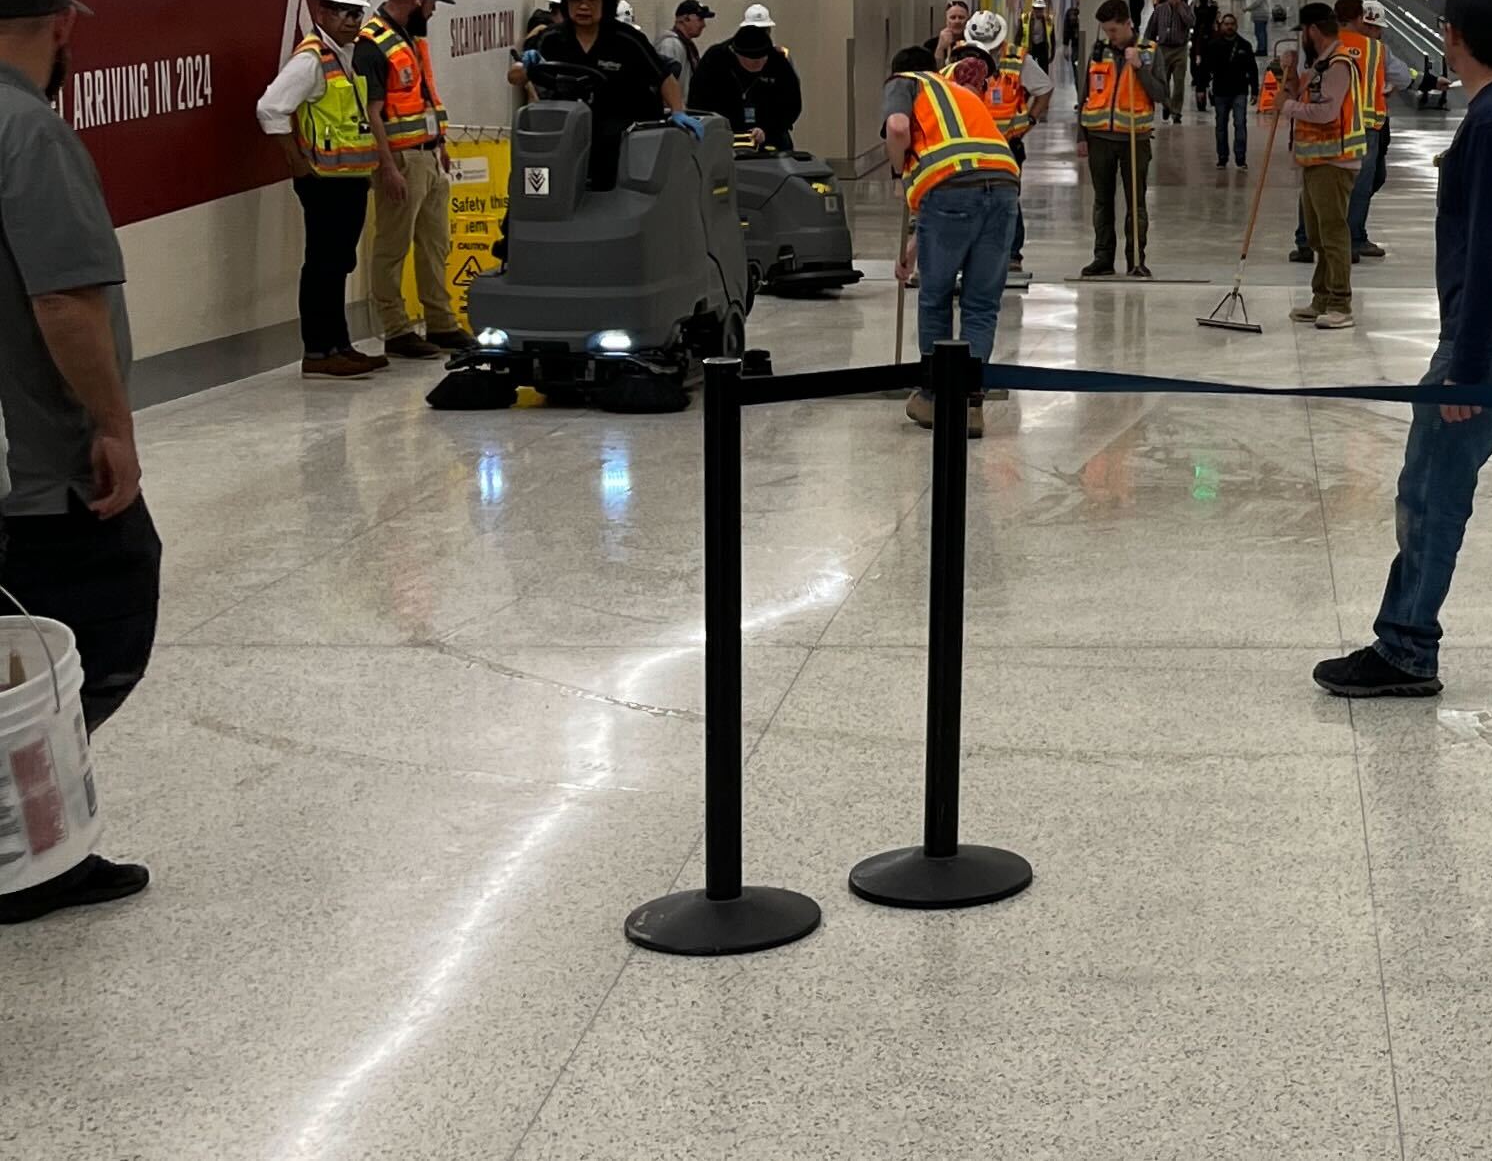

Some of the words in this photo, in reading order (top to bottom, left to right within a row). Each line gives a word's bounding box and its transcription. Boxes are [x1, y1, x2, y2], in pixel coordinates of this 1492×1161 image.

[73, 63, 149, 130] ARRIVING
[154, 60, 172, 114] IN
[176, 54, 212, 110] 2024
[452, 197, 487, 213] Safety
